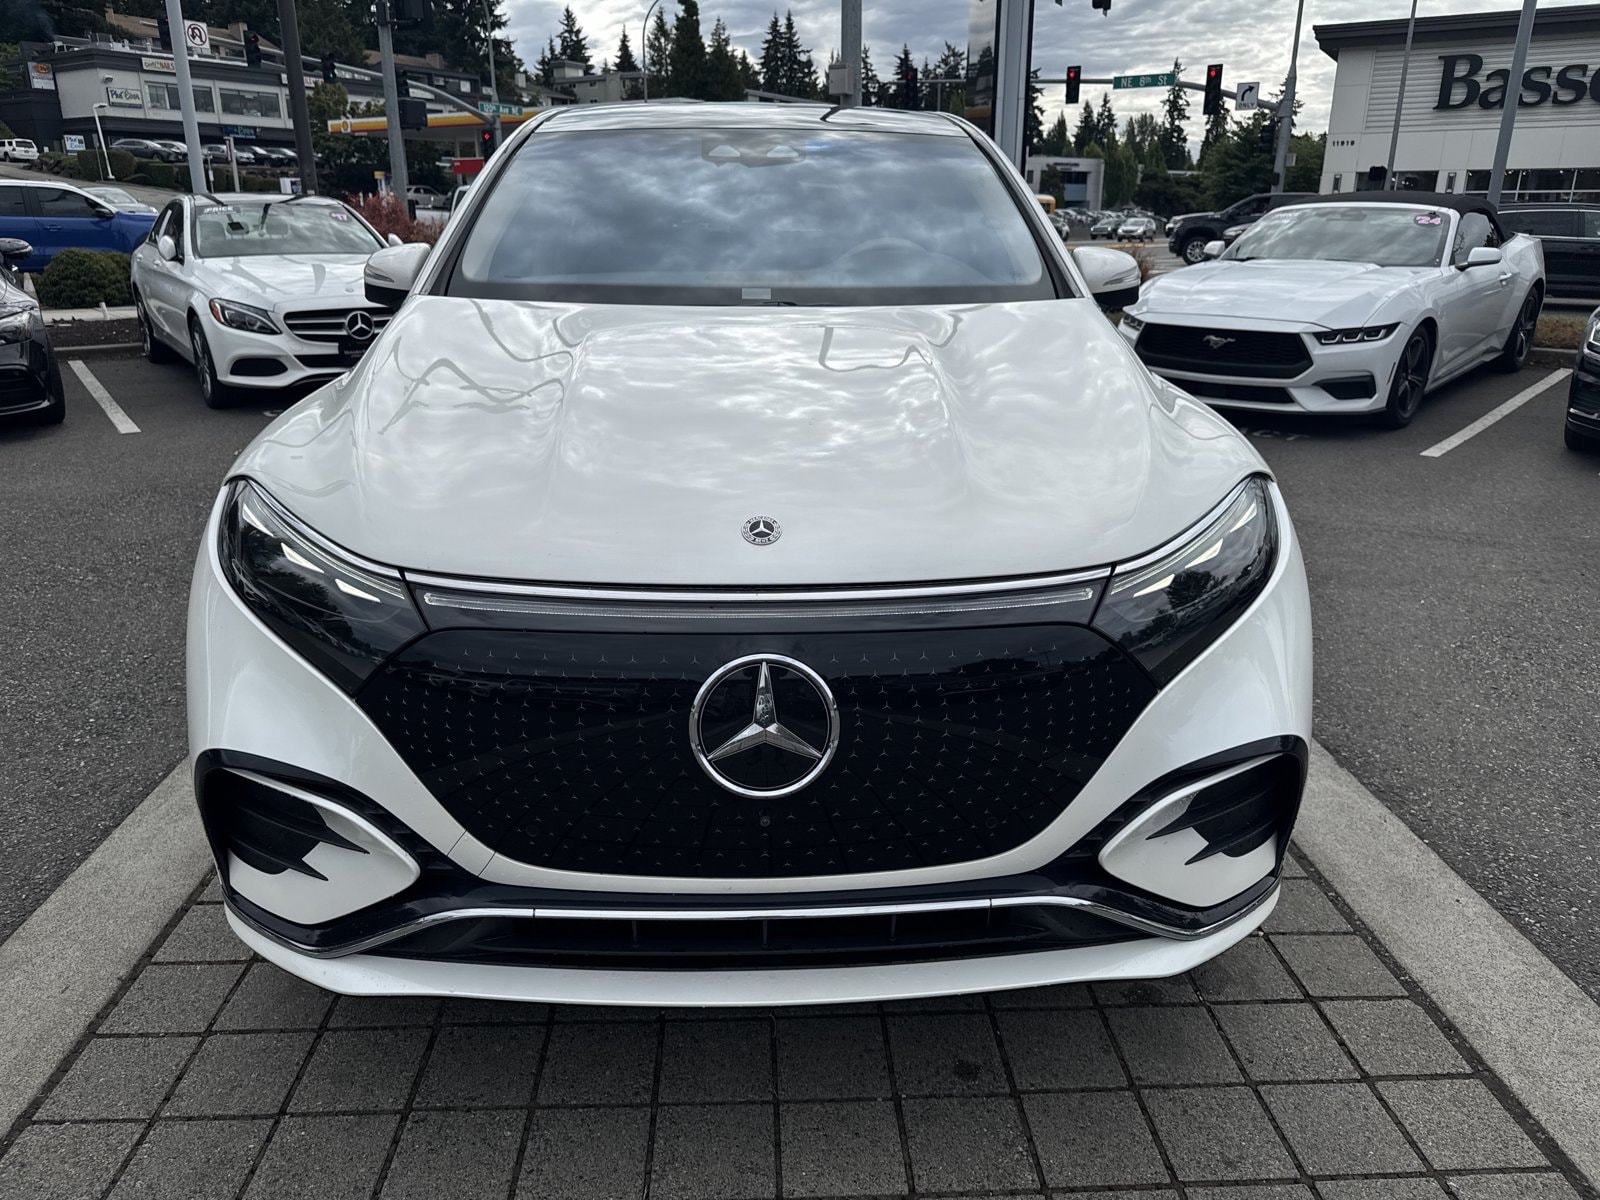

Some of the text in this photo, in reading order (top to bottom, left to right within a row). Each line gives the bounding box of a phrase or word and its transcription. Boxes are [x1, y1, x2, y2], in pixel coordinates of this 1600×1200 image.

[1121, 75, 1167, 87] NE 8th St
